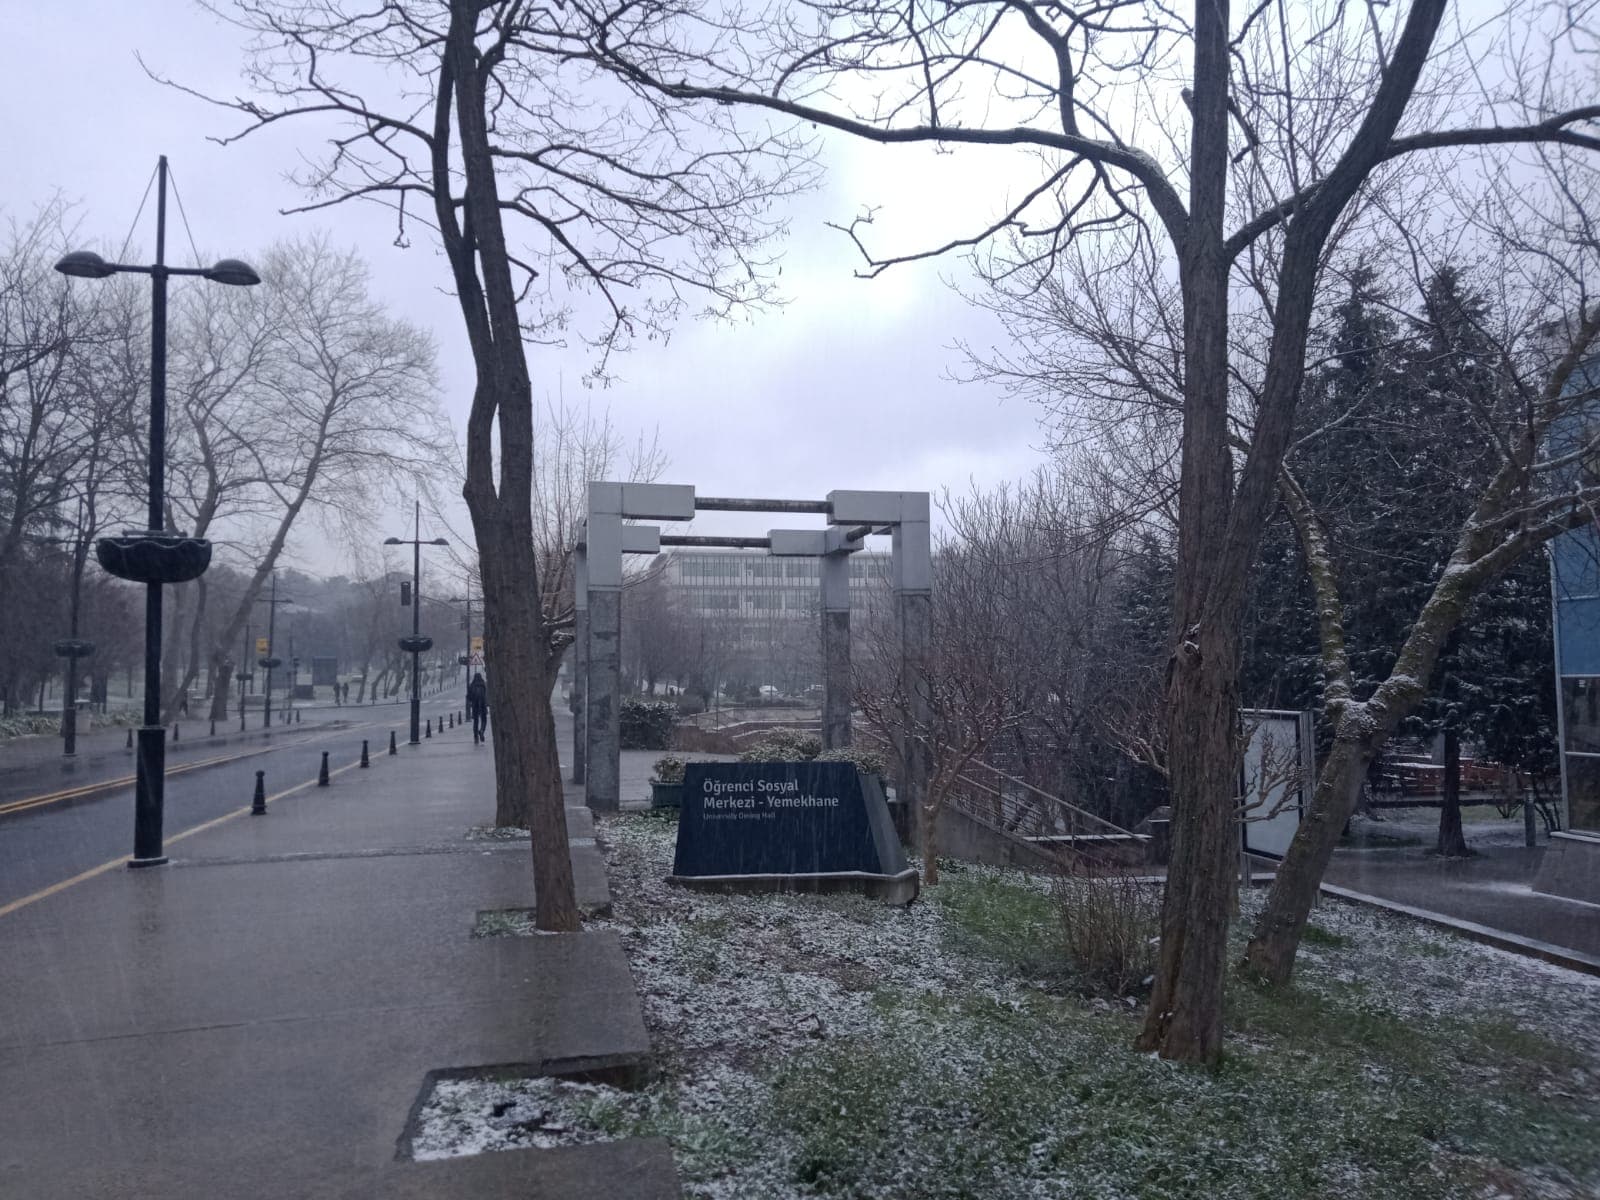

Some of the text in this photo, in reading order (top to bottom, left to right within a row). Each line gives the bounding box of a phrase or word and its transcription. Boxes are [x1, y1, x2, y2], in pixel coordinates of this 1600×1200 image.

[703, 778, 799, 795] Öğrenci Sosyal
[703, 796, 755, 808] Merkezi
[767, 795, 839, 808] Yemekhane
